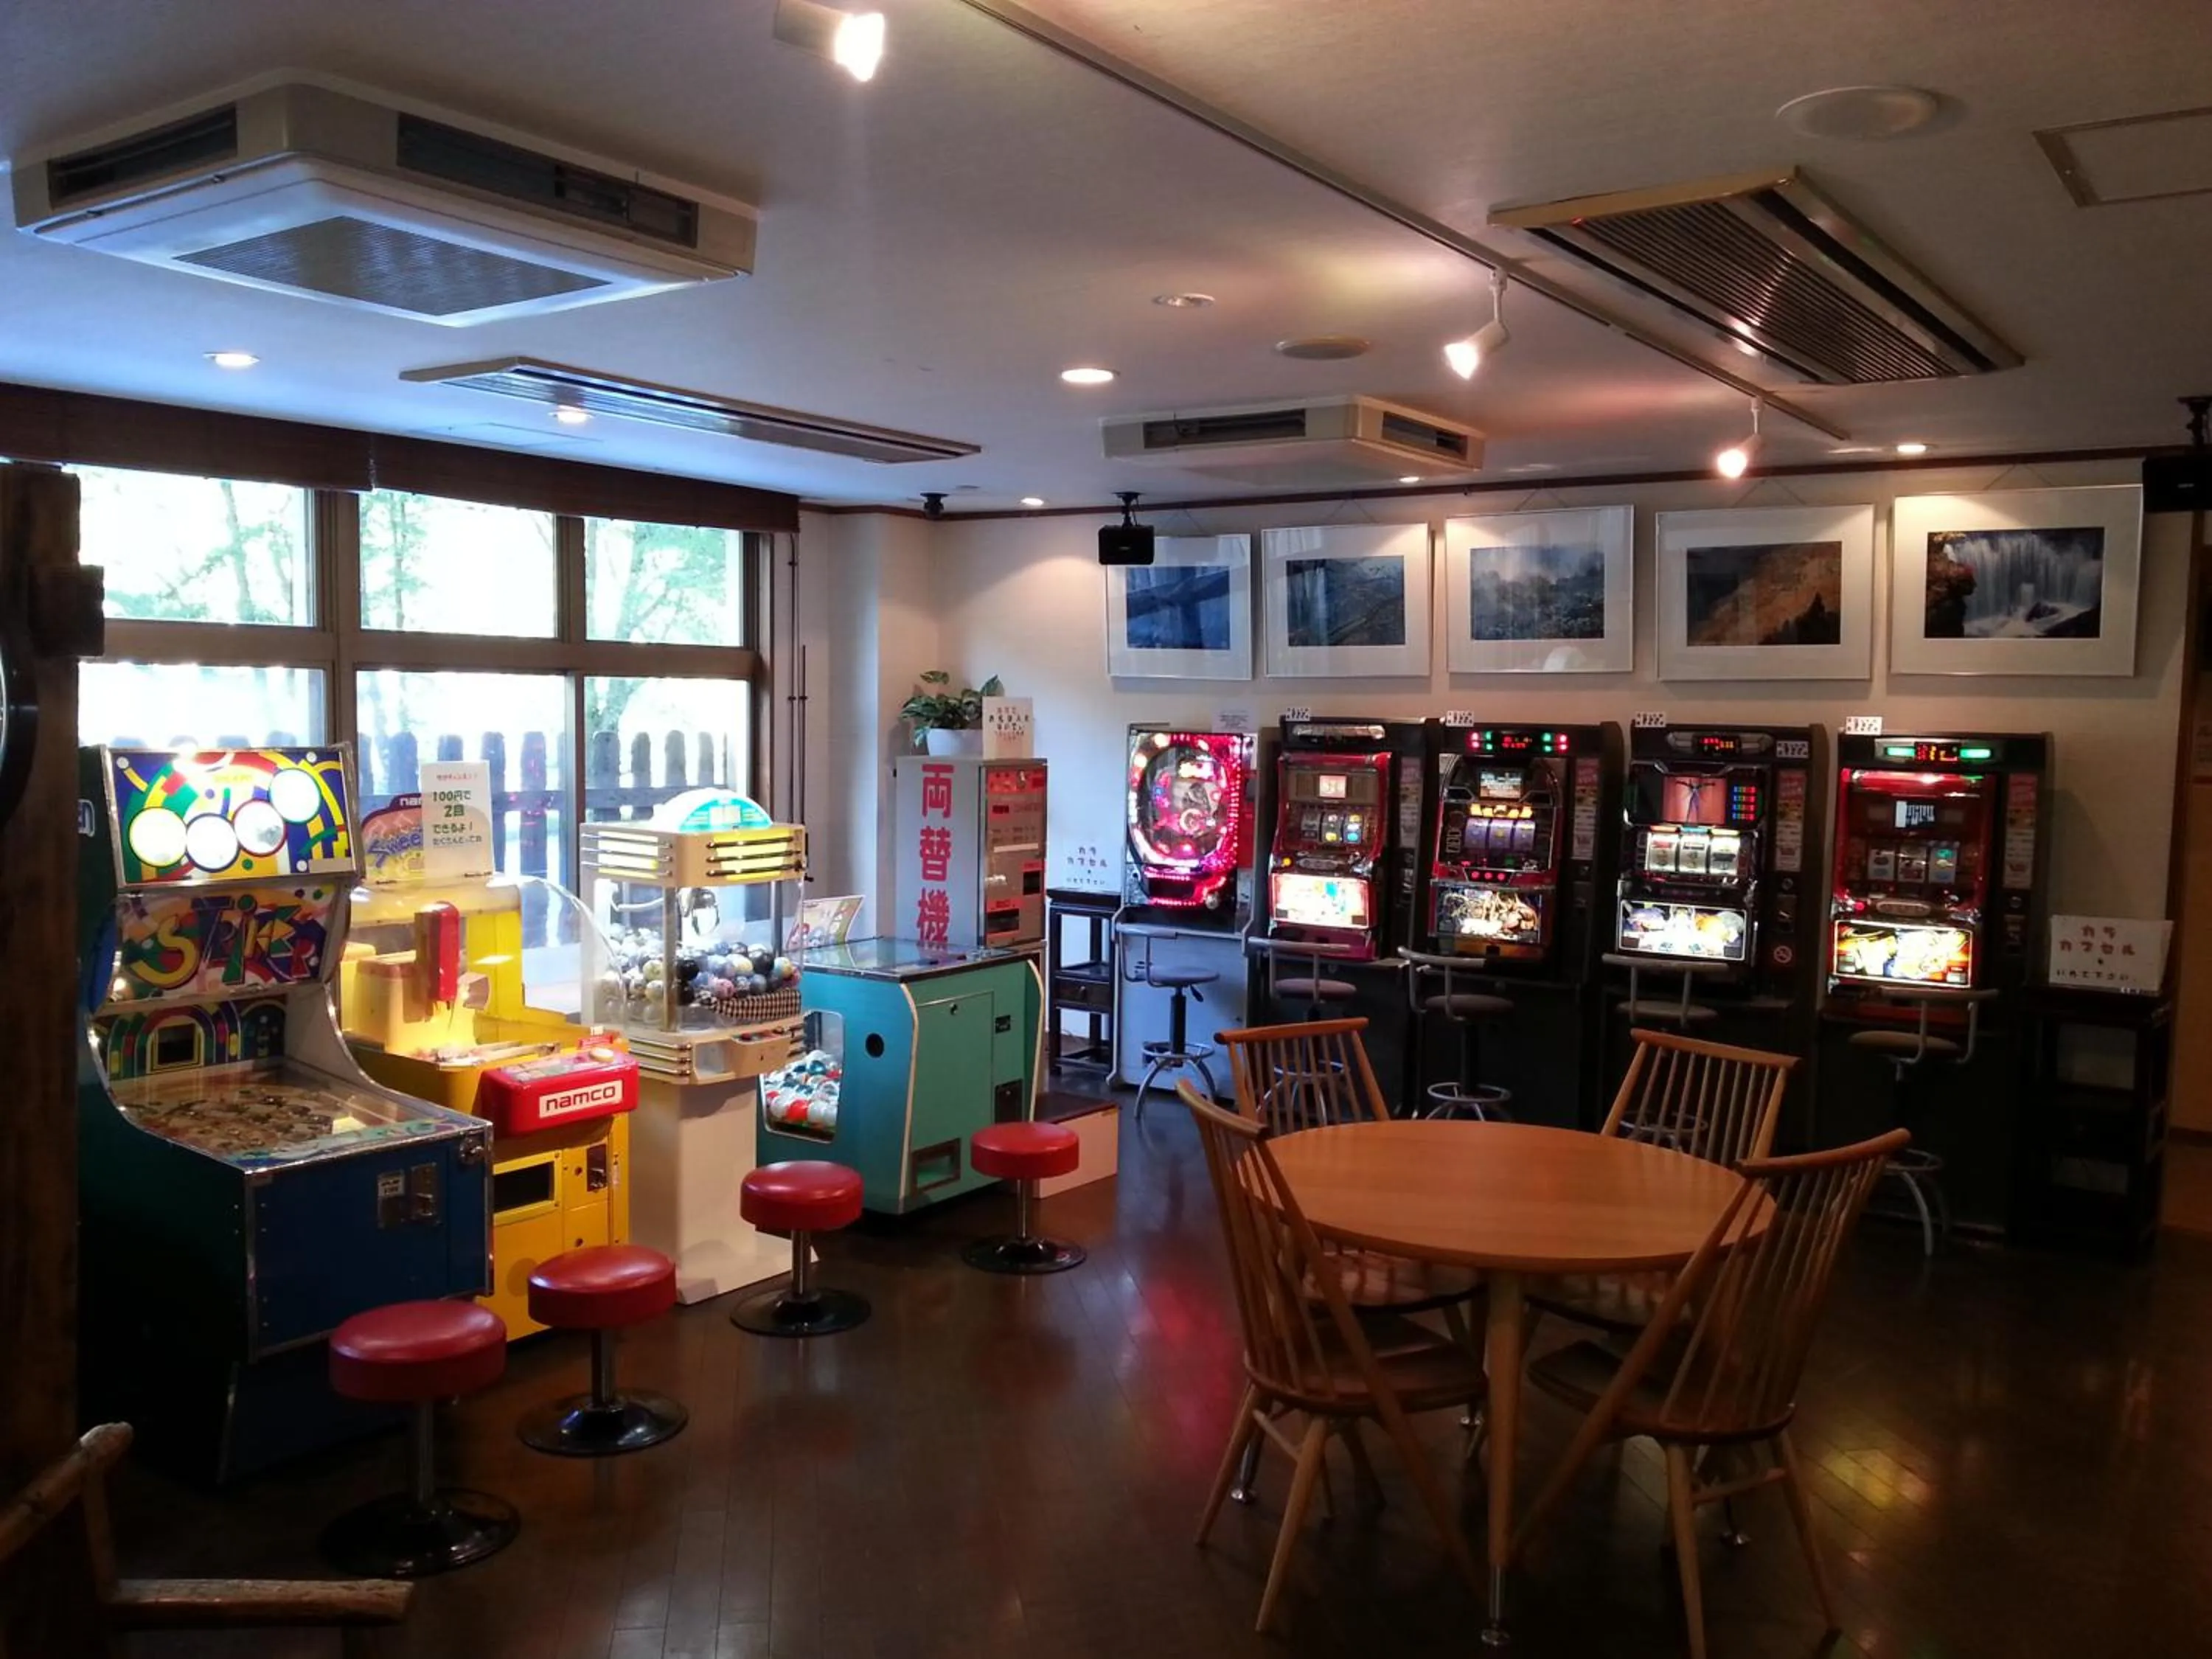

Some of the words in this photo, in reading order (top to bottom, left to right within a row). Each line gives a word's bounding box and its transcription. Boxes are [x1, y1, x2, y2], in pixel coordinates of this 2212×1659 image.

[444, 804, 465, 818] 2回
[917, 764, 954, 942] 両替機
[546, 1085, 616, 1112] namco
